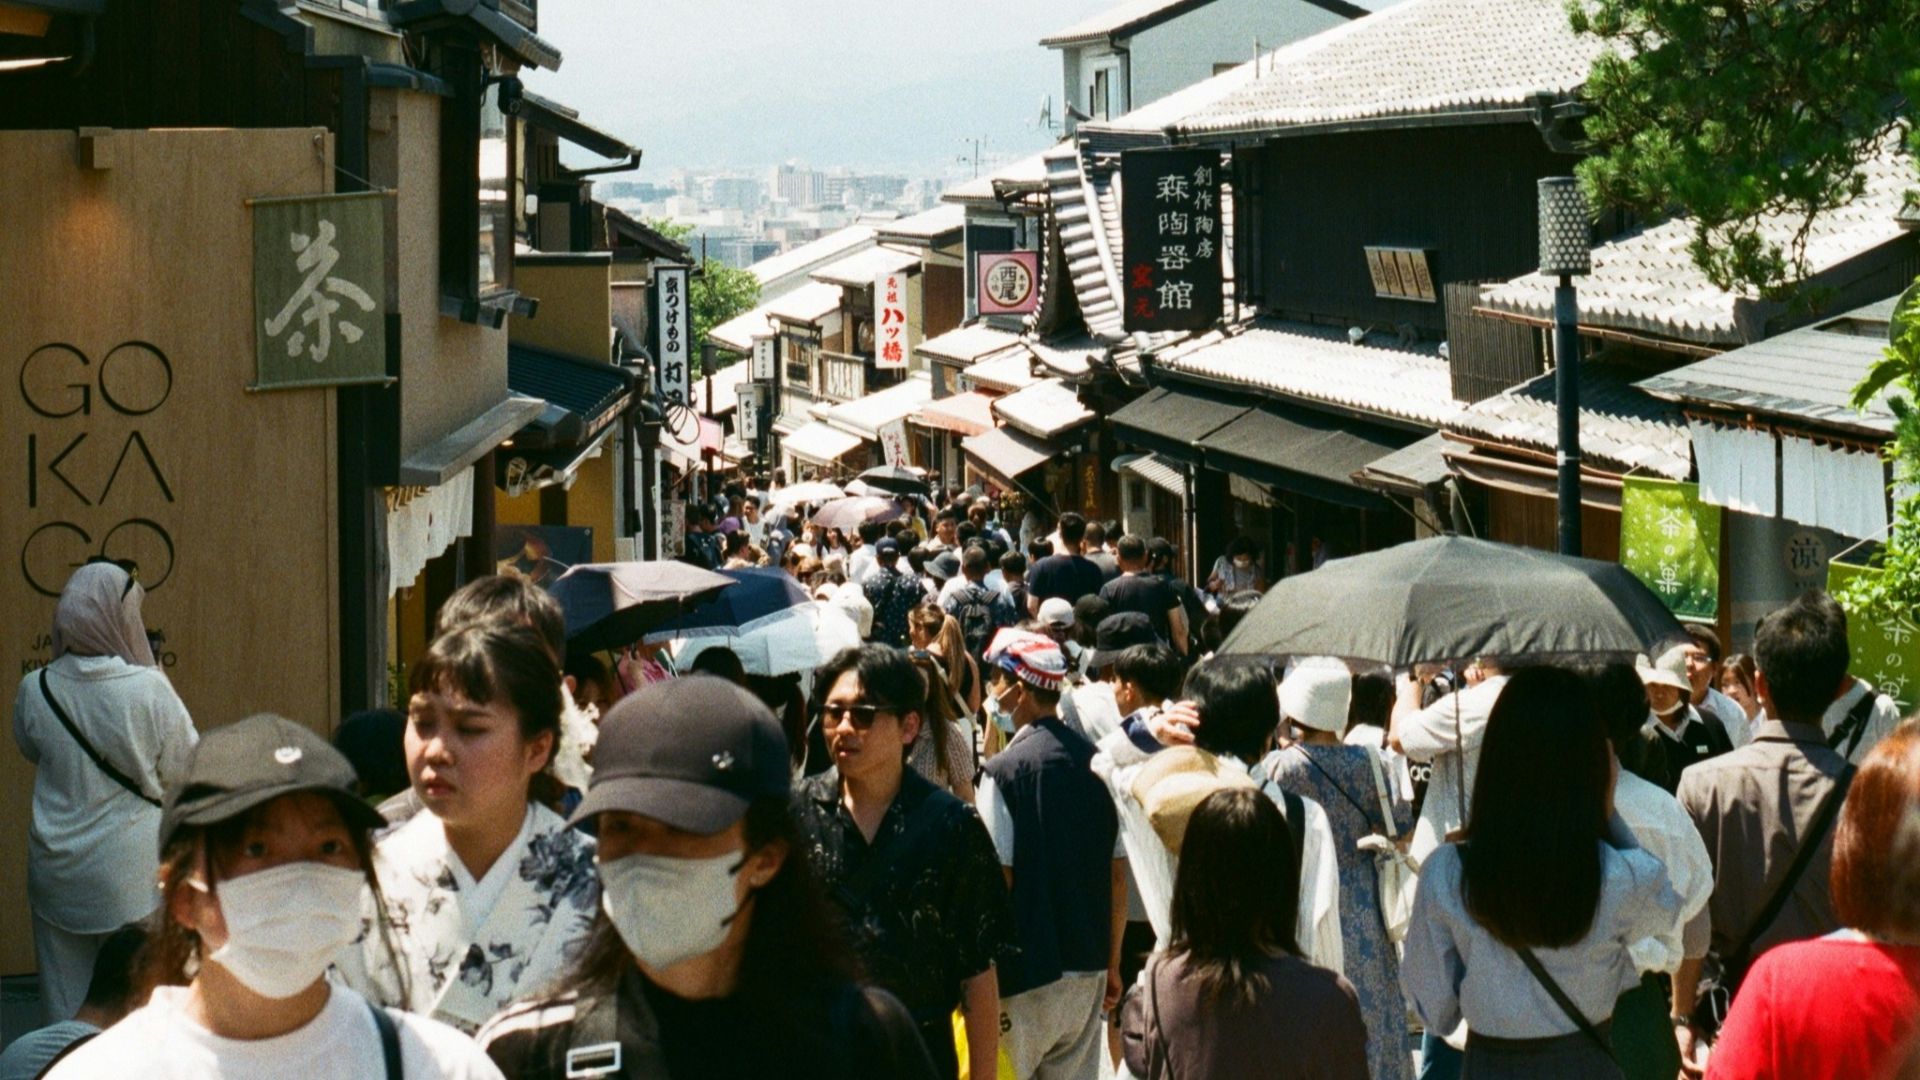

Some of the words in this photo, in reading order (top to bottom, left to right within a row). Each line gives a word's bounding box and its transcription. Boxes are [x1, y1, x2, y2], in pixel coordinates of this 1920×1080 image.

[1155, 173, 1194, 310] 森陶器館
[1193, 165, 1214, 259] 創作陶房
[264, 219, 377, 363] 茶
[998, 266, 1018, 300] 西尾
[19, 340, 172, 418] GO
[28, 429, 175, 508] KA
